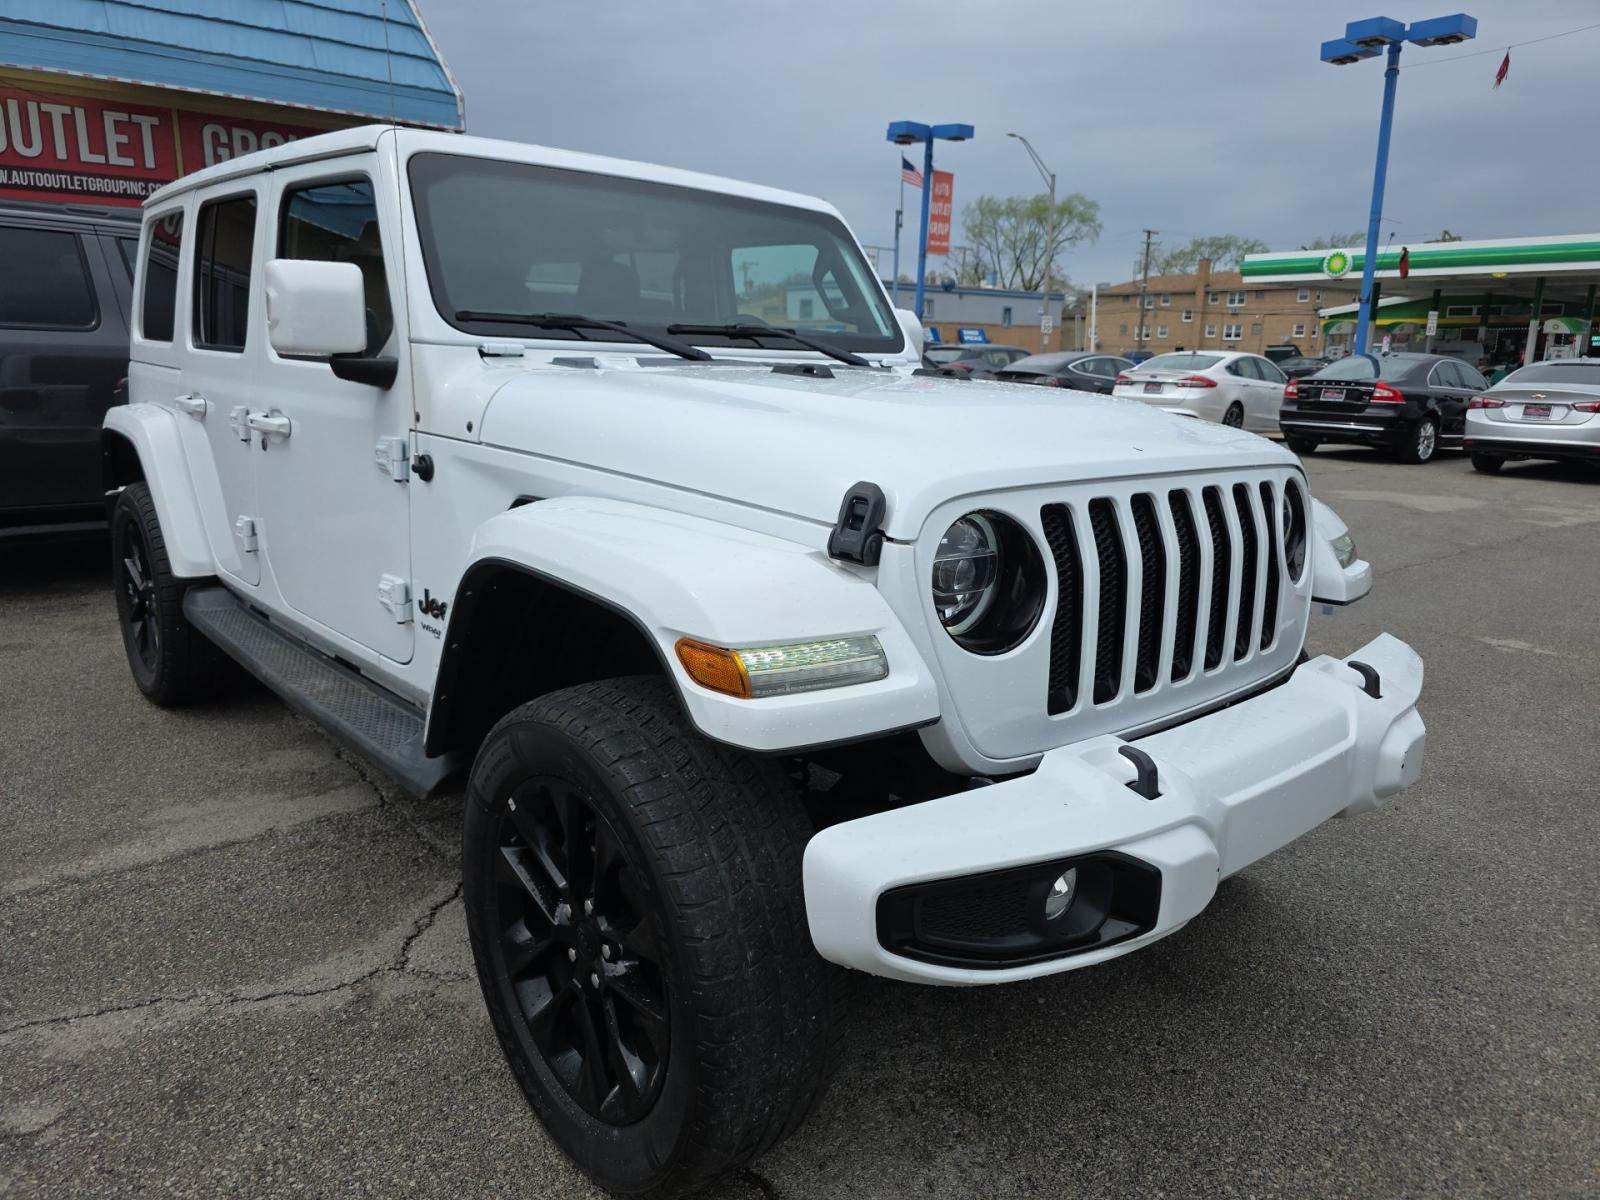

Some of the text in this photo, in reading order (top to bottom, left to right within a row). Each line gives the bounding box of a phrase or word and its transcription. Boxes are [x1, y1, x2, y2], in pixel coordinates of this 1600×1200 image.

[0, 98, 298, 169] UTLET GR
[929, 222, 949, 236] GROUP
